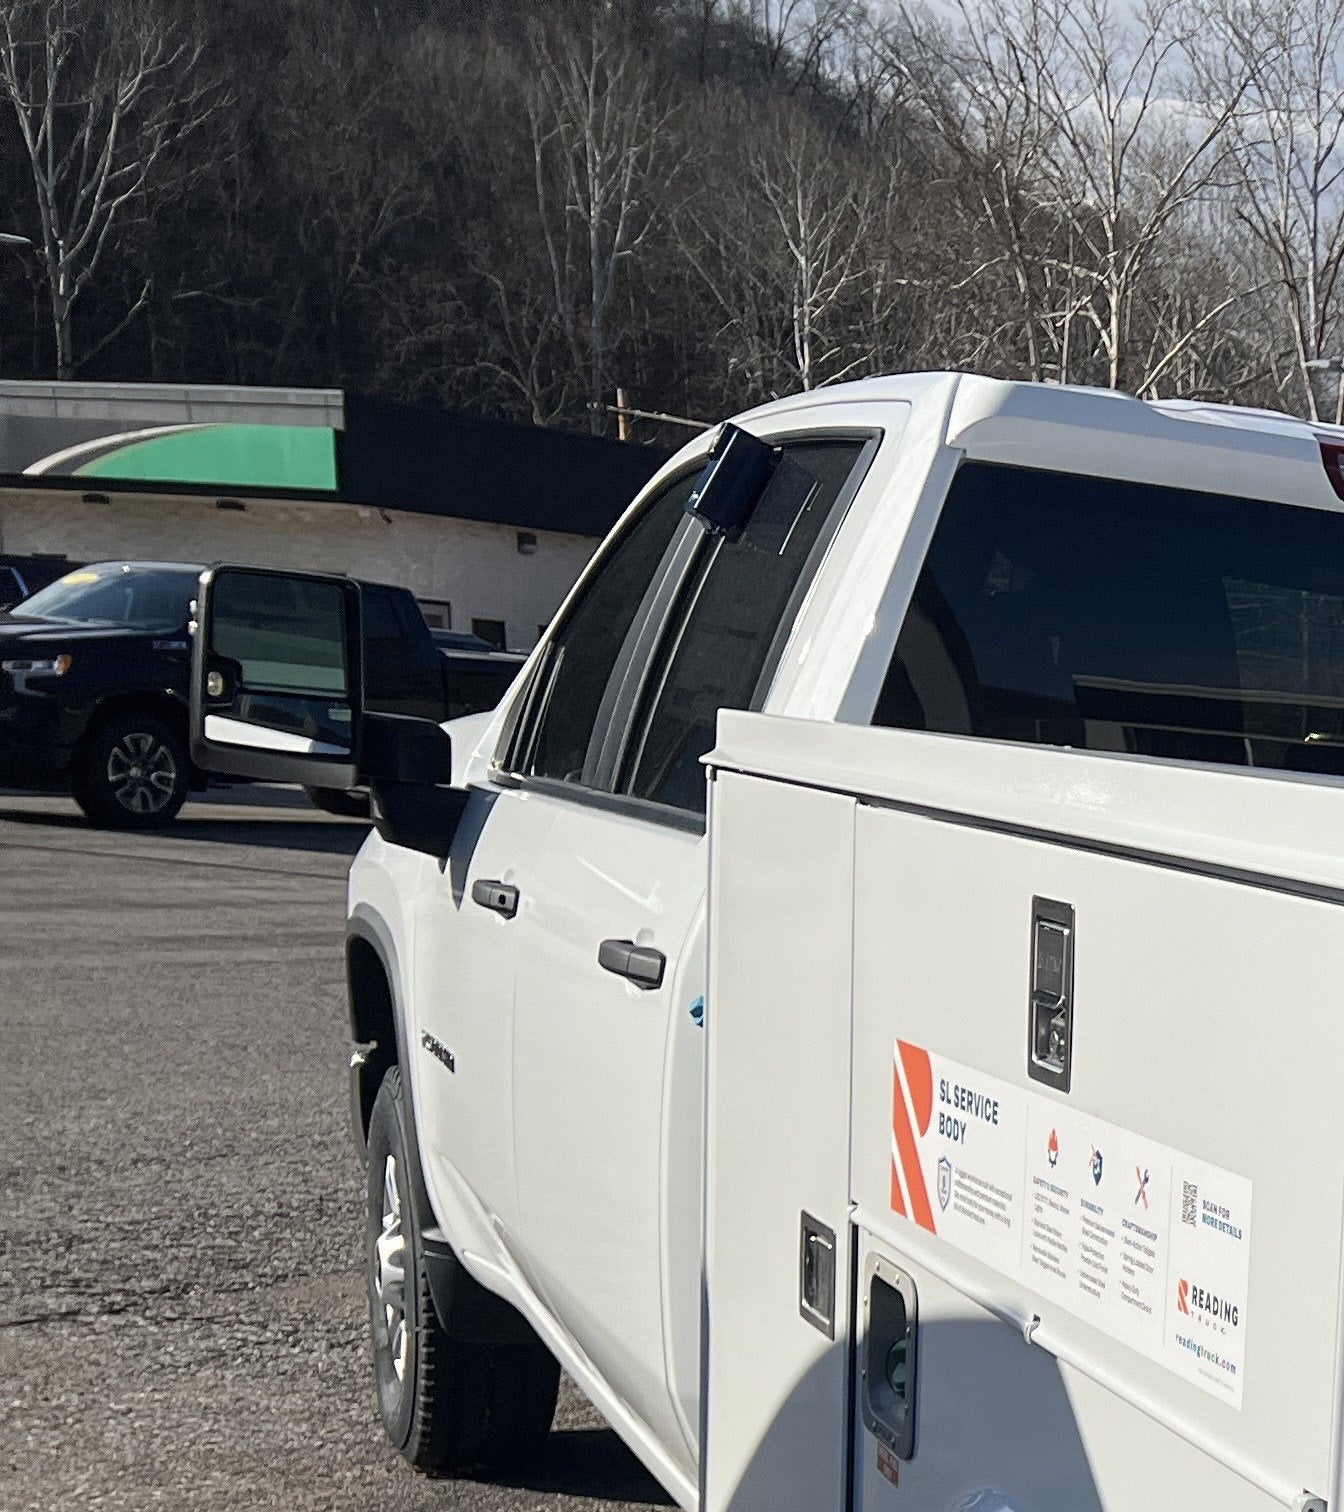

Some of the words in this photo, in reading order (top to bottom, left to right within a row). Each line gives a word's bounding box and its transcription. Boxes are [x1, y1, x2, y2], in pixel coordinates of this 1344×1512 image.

[939, 1078, 951, 1105] SL
[953, 1084, 999, 1125] SERVICE
[938, 1112, 967, 1145] BODY
[1202, 1198, 1218, 1215] SCAN
[1218, 1205, 1230, 1220] FOR
[1202, 1212, 1218, 1230] MORE
[1219, 1220, 1242, 1240] DETAILS
[1191, 1284, 1238, 1327] READING
[1175, 1334, 1236, 1375] readingtruck.com
